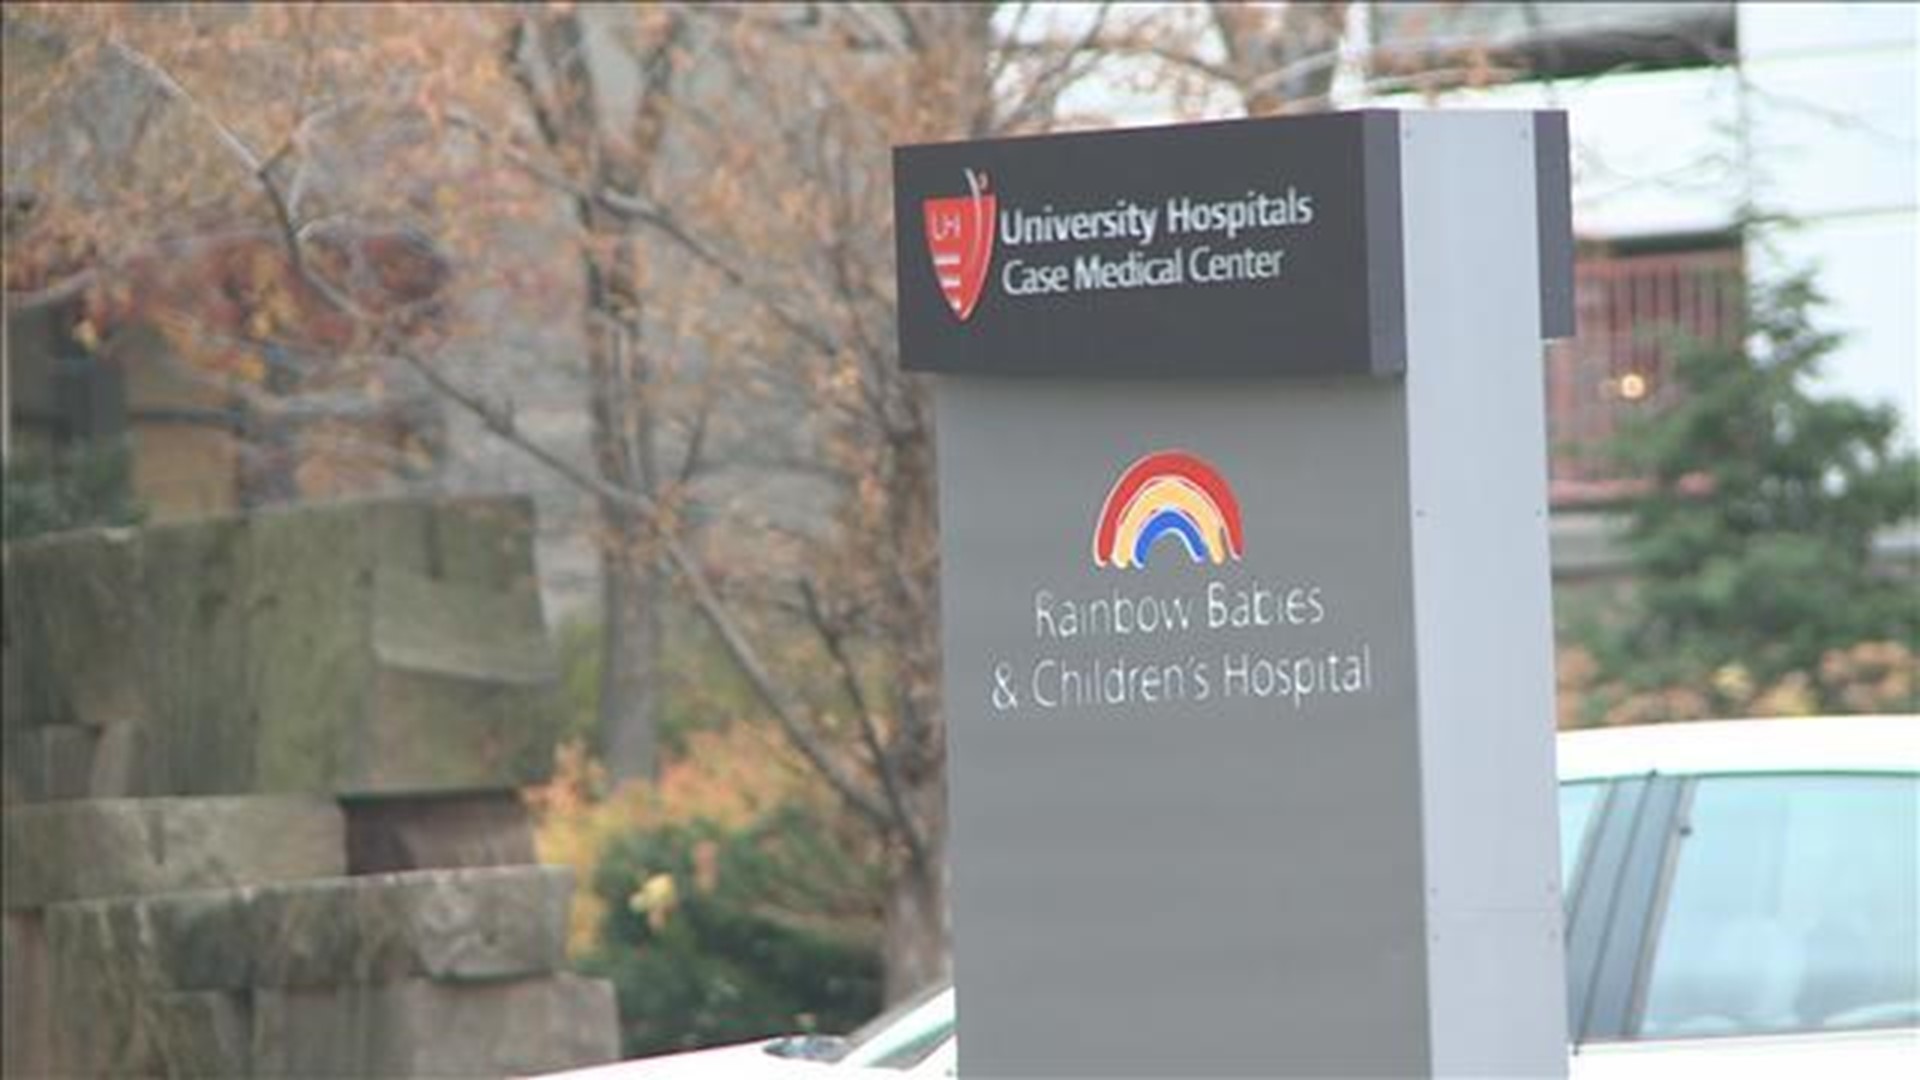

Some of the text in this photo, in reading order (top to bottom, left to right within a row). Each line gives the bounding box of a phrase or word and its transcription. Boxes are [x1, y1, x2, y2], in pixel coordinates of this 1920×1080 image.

[1000, 187, 1312, 245] University Hospitals
[1002, 245, 1283, 295] Case Medical Center
[1034, 581, 1325, 638] Rainbow Babies
[992, 643, 1371, 709] & Children's Hospital
